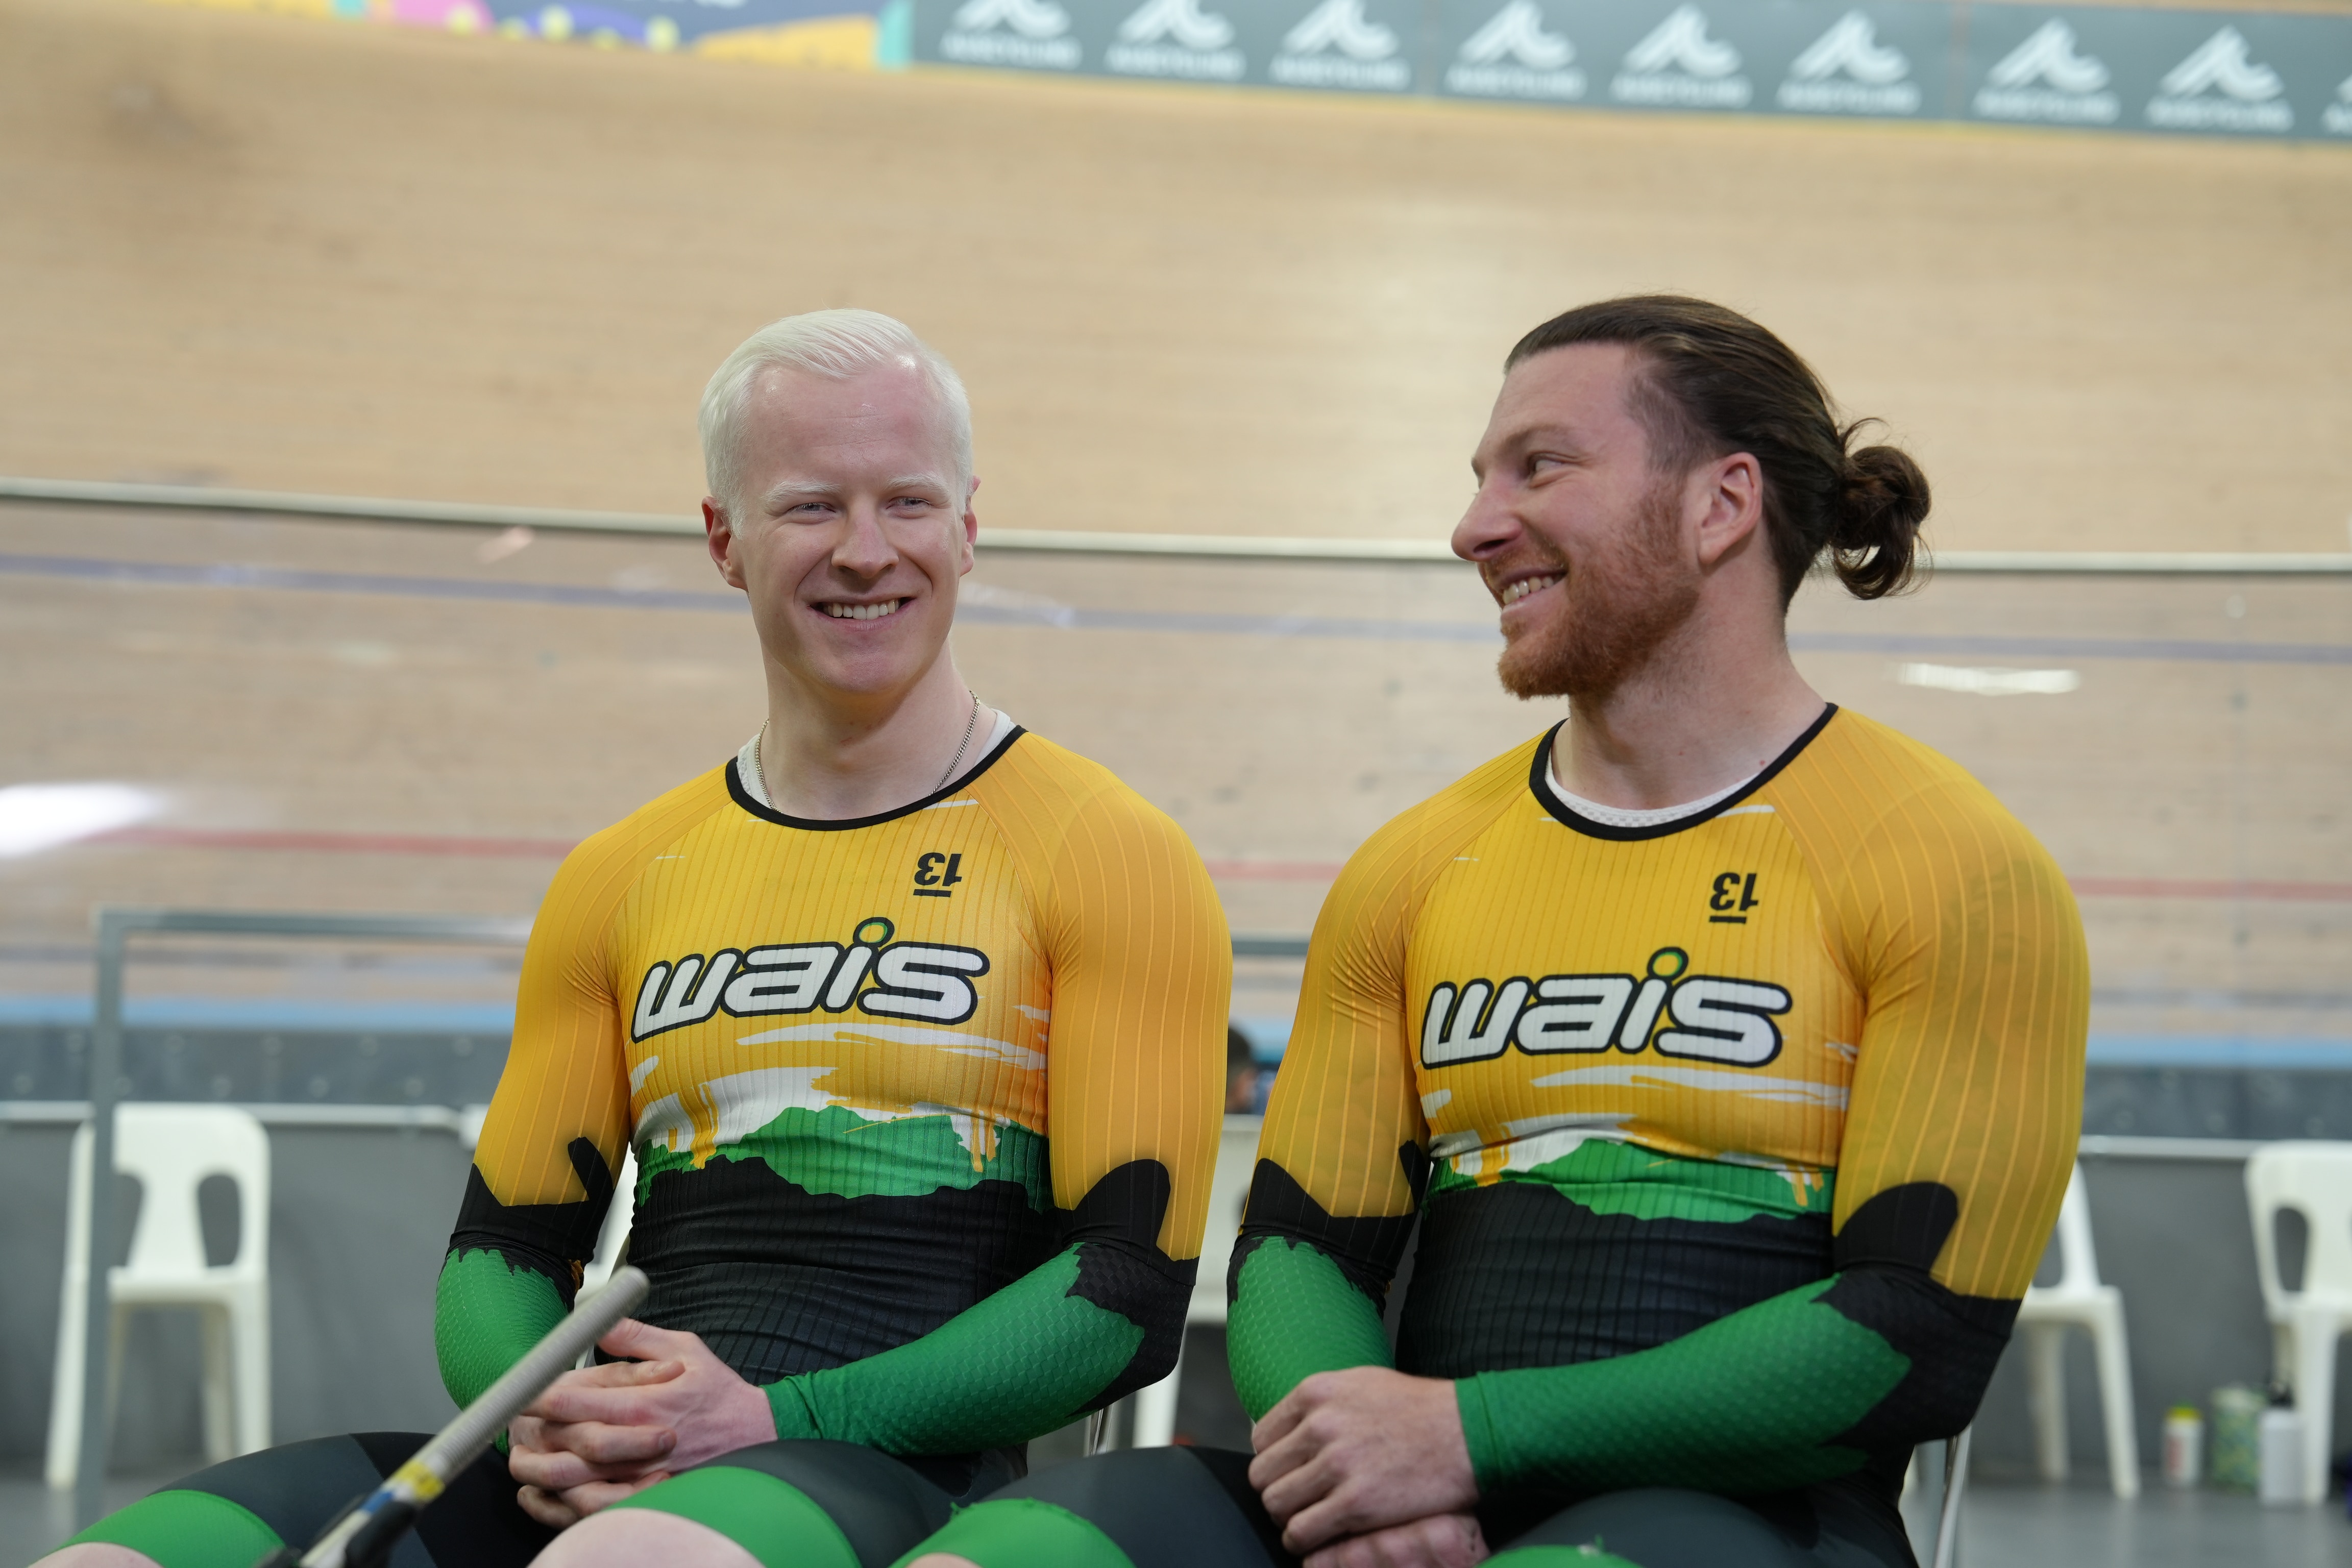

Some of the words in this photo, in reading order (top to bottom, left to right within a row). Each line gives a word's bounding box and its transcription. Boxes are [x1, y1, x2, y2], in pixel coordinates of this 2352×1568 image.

[914, 852, 962, 887] 13
[1709, 872, 1758, 911] 13
[631, 917, 990, 1043] wais
[1420, 946, 1793, 1068] wais
